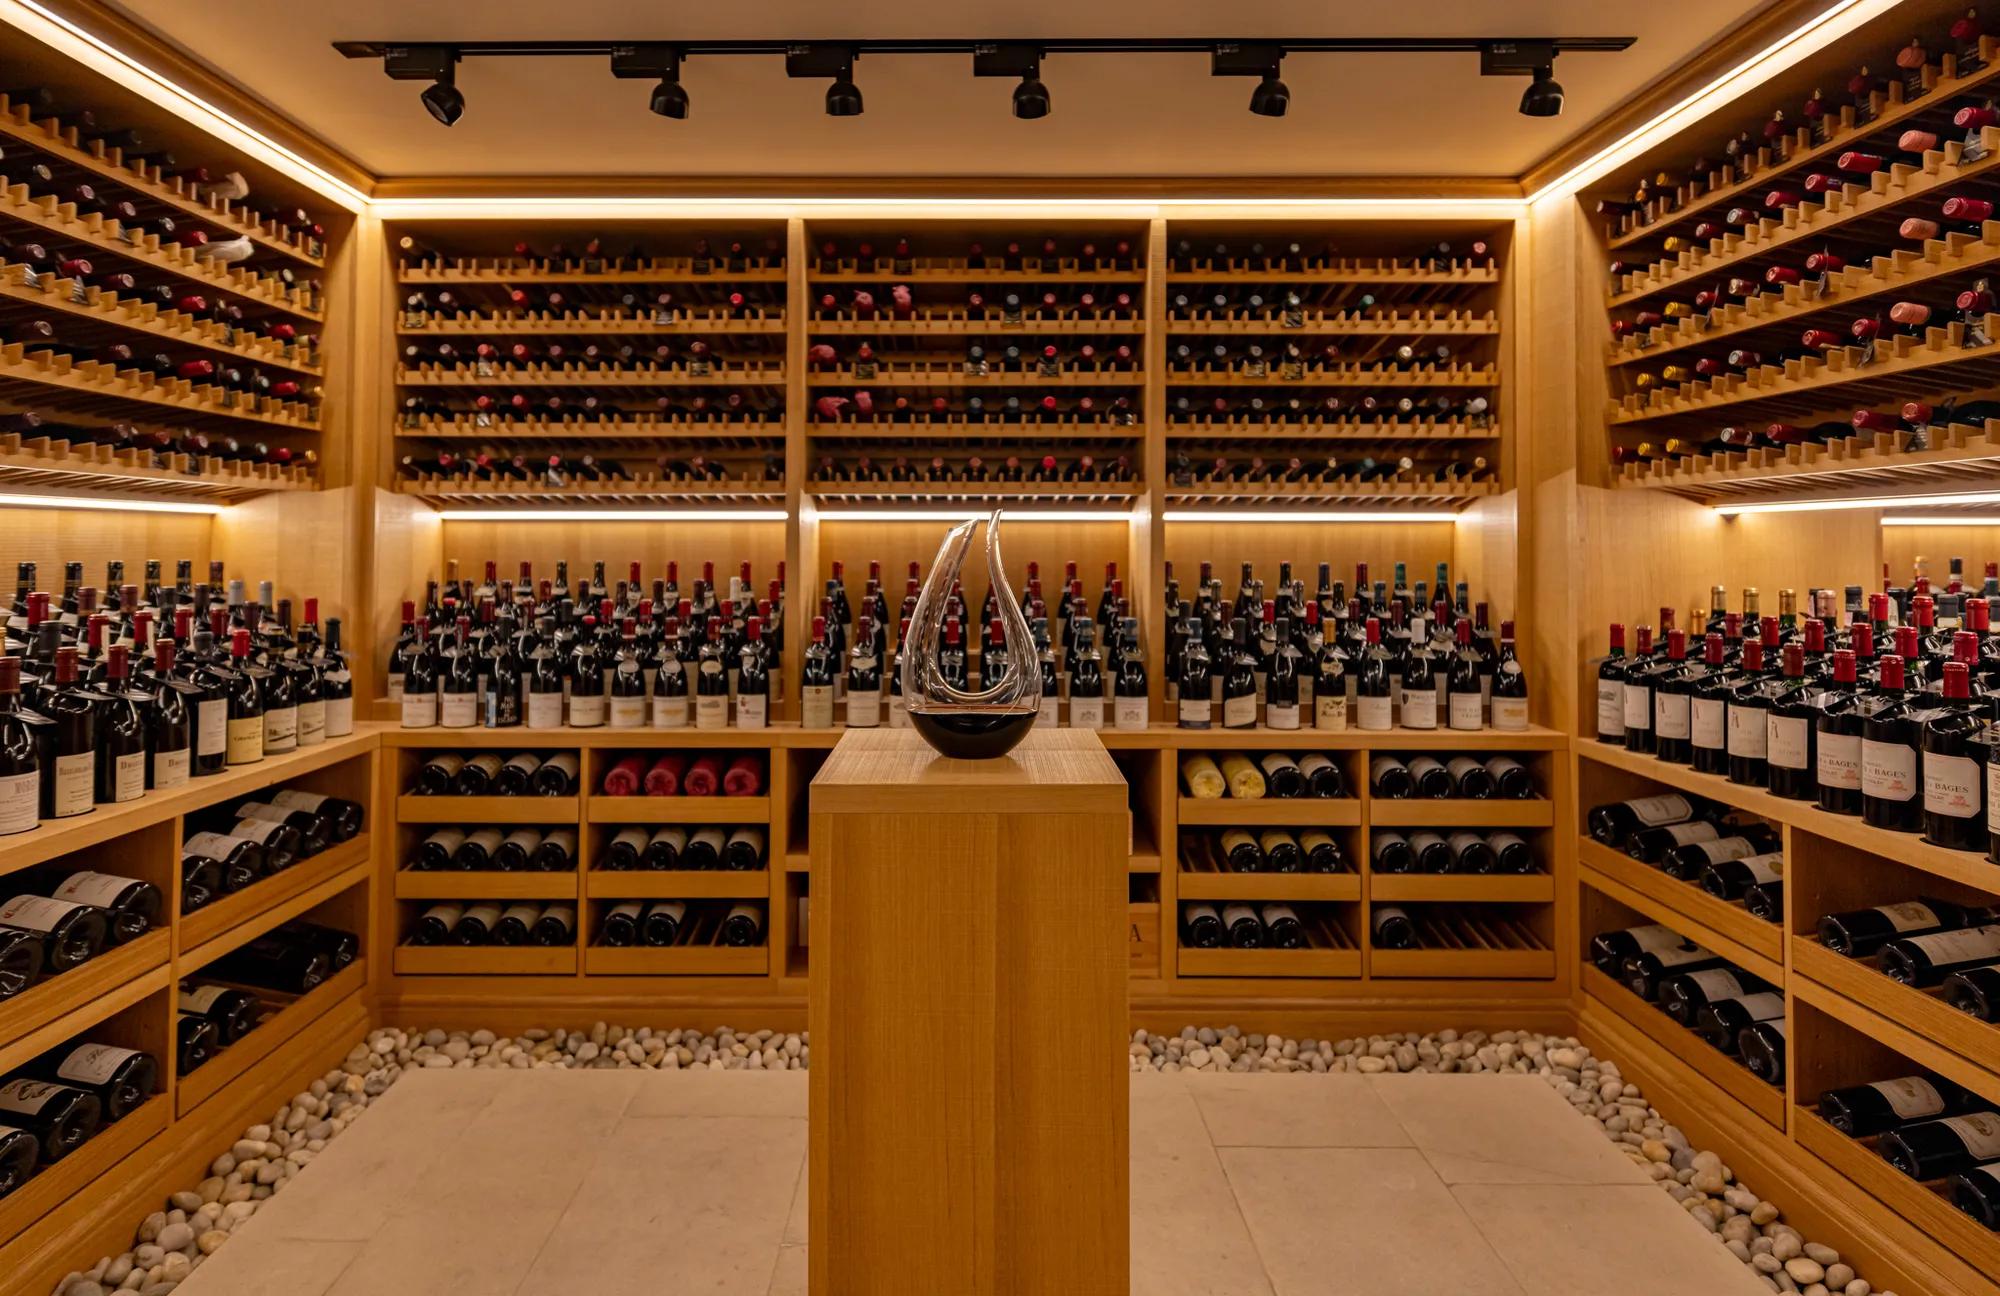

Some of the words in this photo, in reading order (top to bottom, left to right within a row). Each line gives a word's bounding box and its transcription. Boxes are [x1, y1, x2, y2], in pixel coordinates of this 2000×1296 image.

[1828, 759, 1859, 769] BAGES
[1874, 768, 1907, 778] BAGES
[1935, 783, 1969, 793] BAGES
